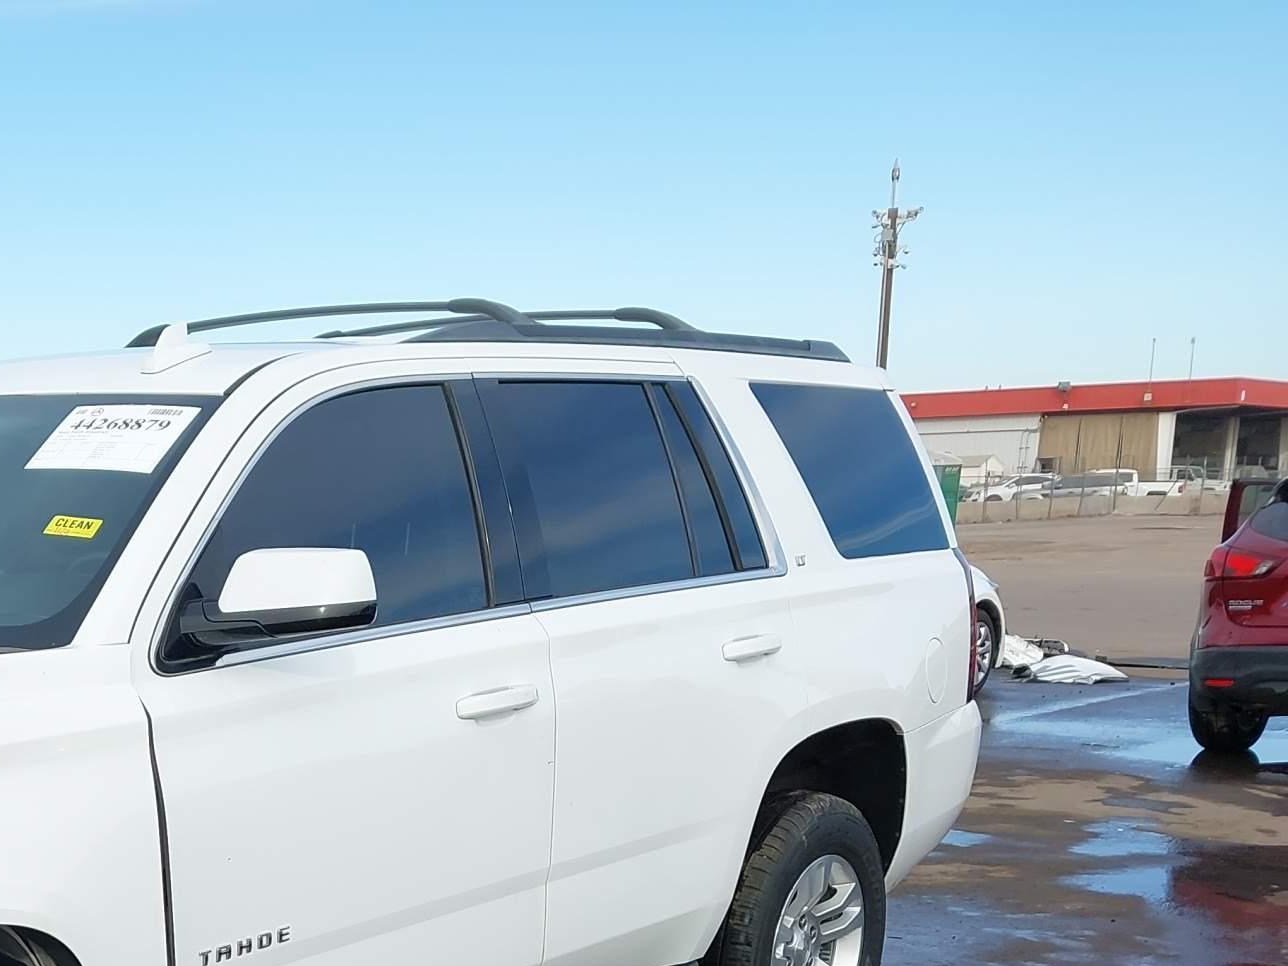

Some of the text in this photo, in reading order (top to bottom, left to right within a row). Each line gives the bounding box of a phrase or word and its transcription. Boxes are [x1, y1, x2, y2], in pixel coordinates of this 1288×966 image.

[70, 417, 172, 431] 44268879
[54, 518, 94, 530] CLEAN
[198, 925, 291, 966] TAHOE
